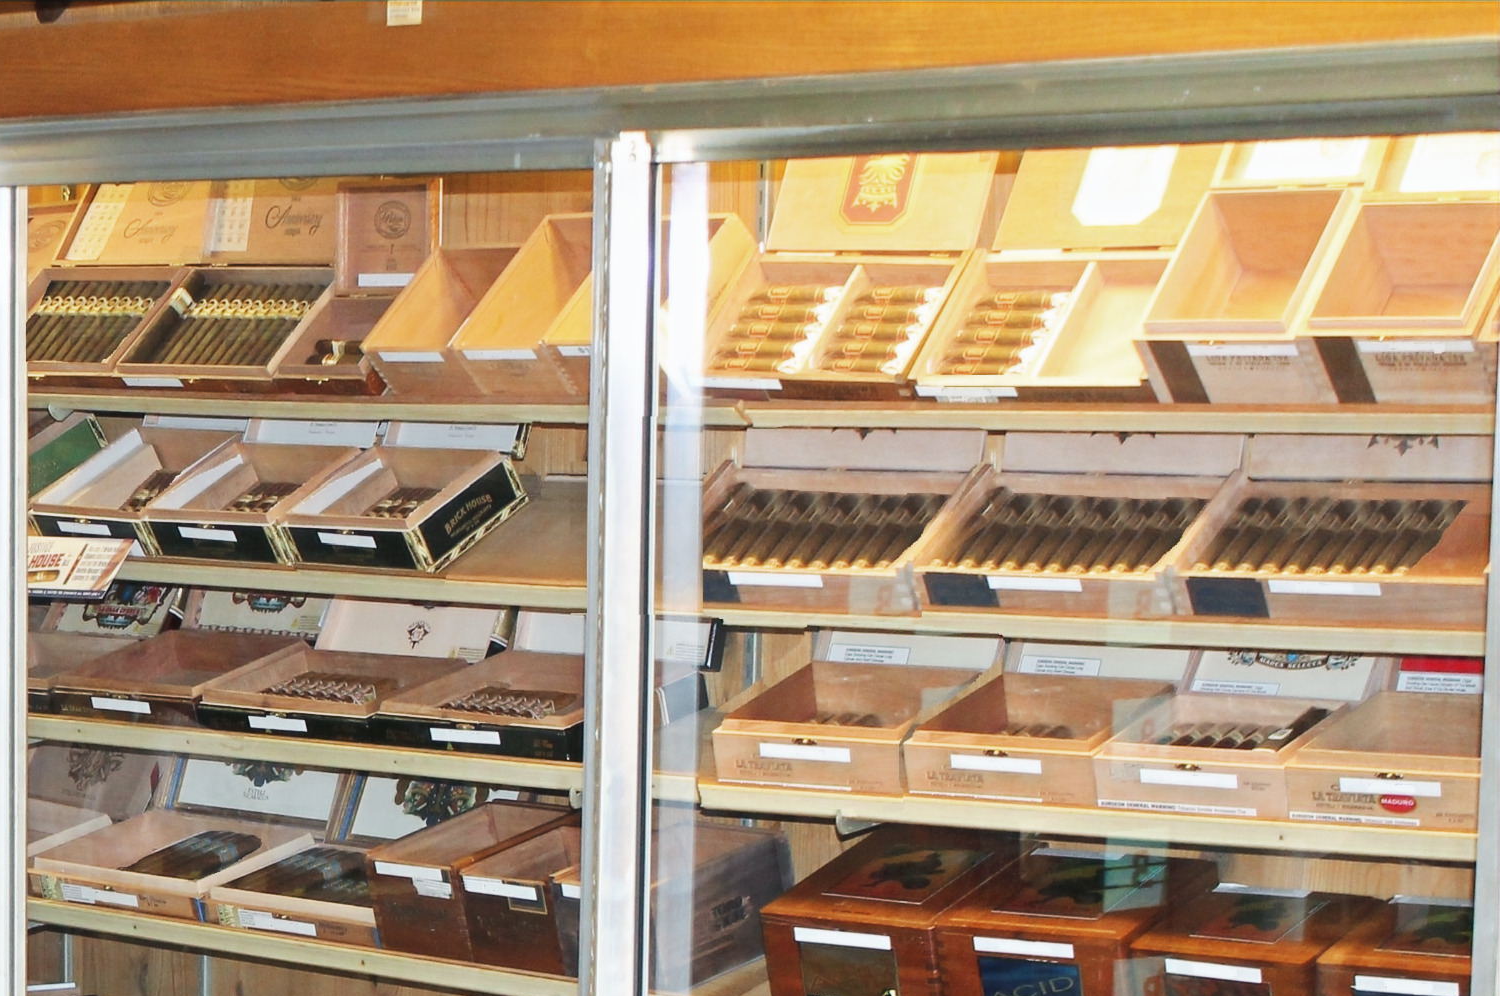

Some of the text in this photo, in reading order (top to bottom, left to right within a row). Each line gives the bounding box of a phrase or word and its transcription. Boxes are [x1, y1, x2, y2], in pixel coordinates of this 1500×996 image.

[445, 508, 467, 535] BRICK
[465, 493, 493, 514] HOUSE
[29, 553, 65, 569] HOUSE
[736, 759, 793, 772] LA TRAVIATA
[927, 771, 984, 783] LA TRAVIATA
[1381, 797, 1415, 807] MADURO
